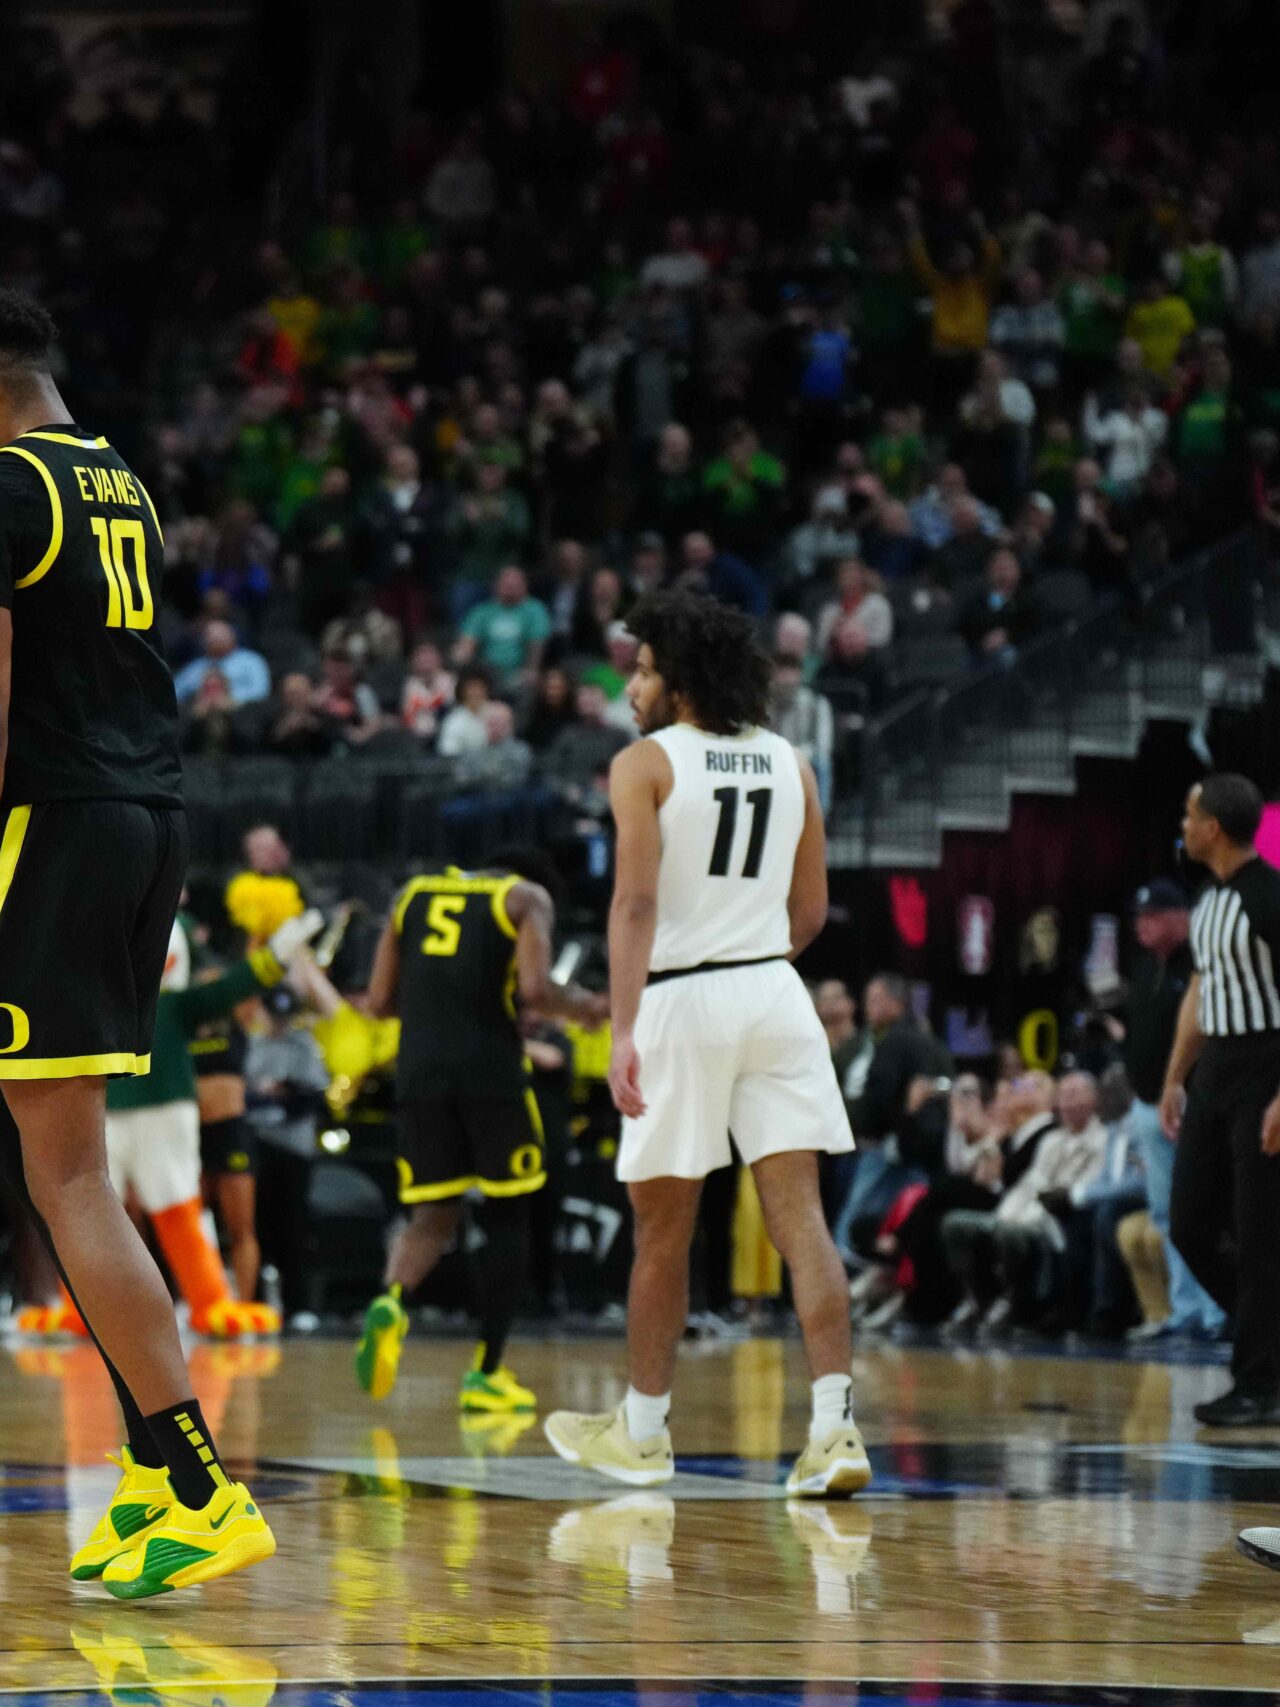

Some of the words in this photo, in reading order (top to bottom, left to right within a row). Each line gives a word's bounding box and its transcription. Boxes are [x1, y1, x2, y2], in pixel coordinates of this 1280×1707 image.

[73, 466, 141, 506] EVANS
[90, 517, 154, 630] 10
[705, 750, 773, 775] RUFFIN
[707, 786, 773, 879] 11
[422, 894, 466, 957] 5
